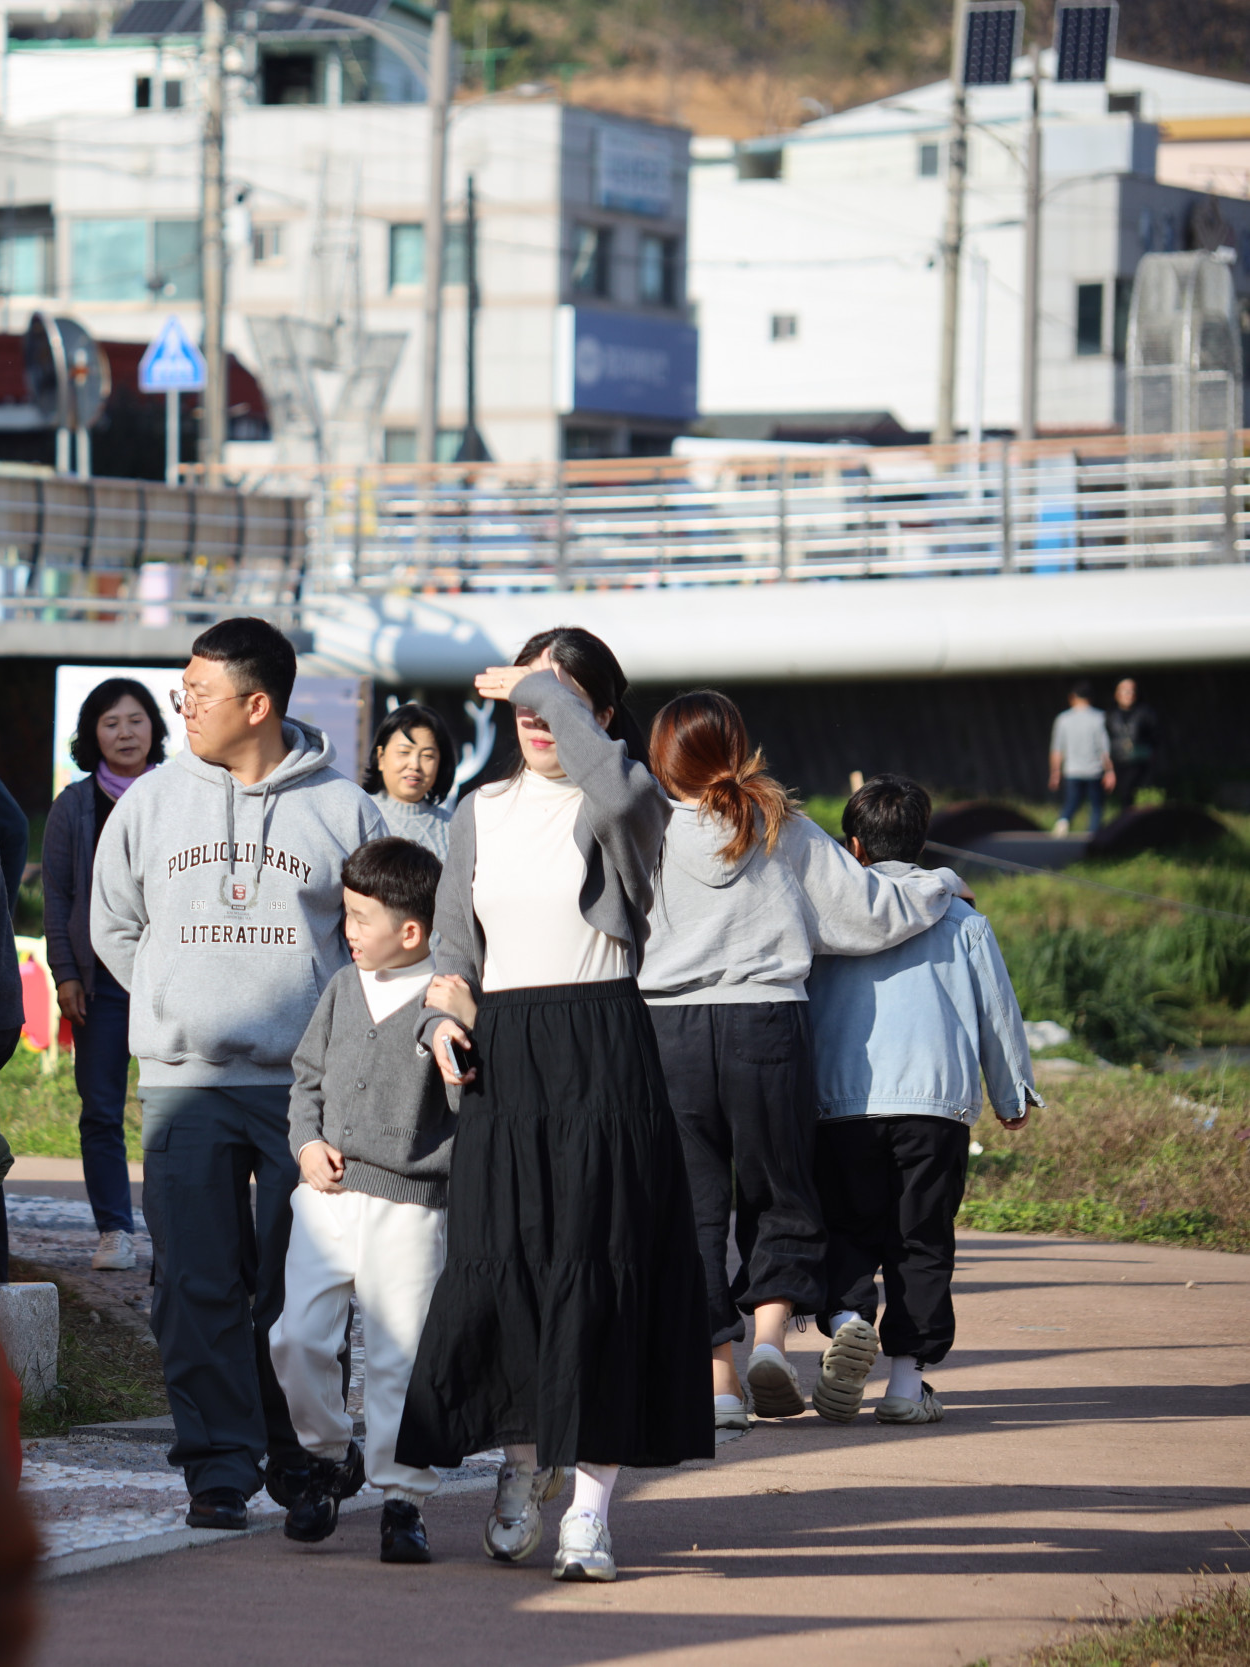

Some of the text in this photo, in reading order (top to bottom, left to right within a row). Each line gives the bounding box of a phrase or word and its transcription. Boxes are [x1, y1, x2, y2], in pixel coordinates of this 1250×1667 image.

[167, 841, 230, 879] PUBLIC
[268, 901, 288, 910] 1998
[180, 924, 298, 945] LITERATURE
